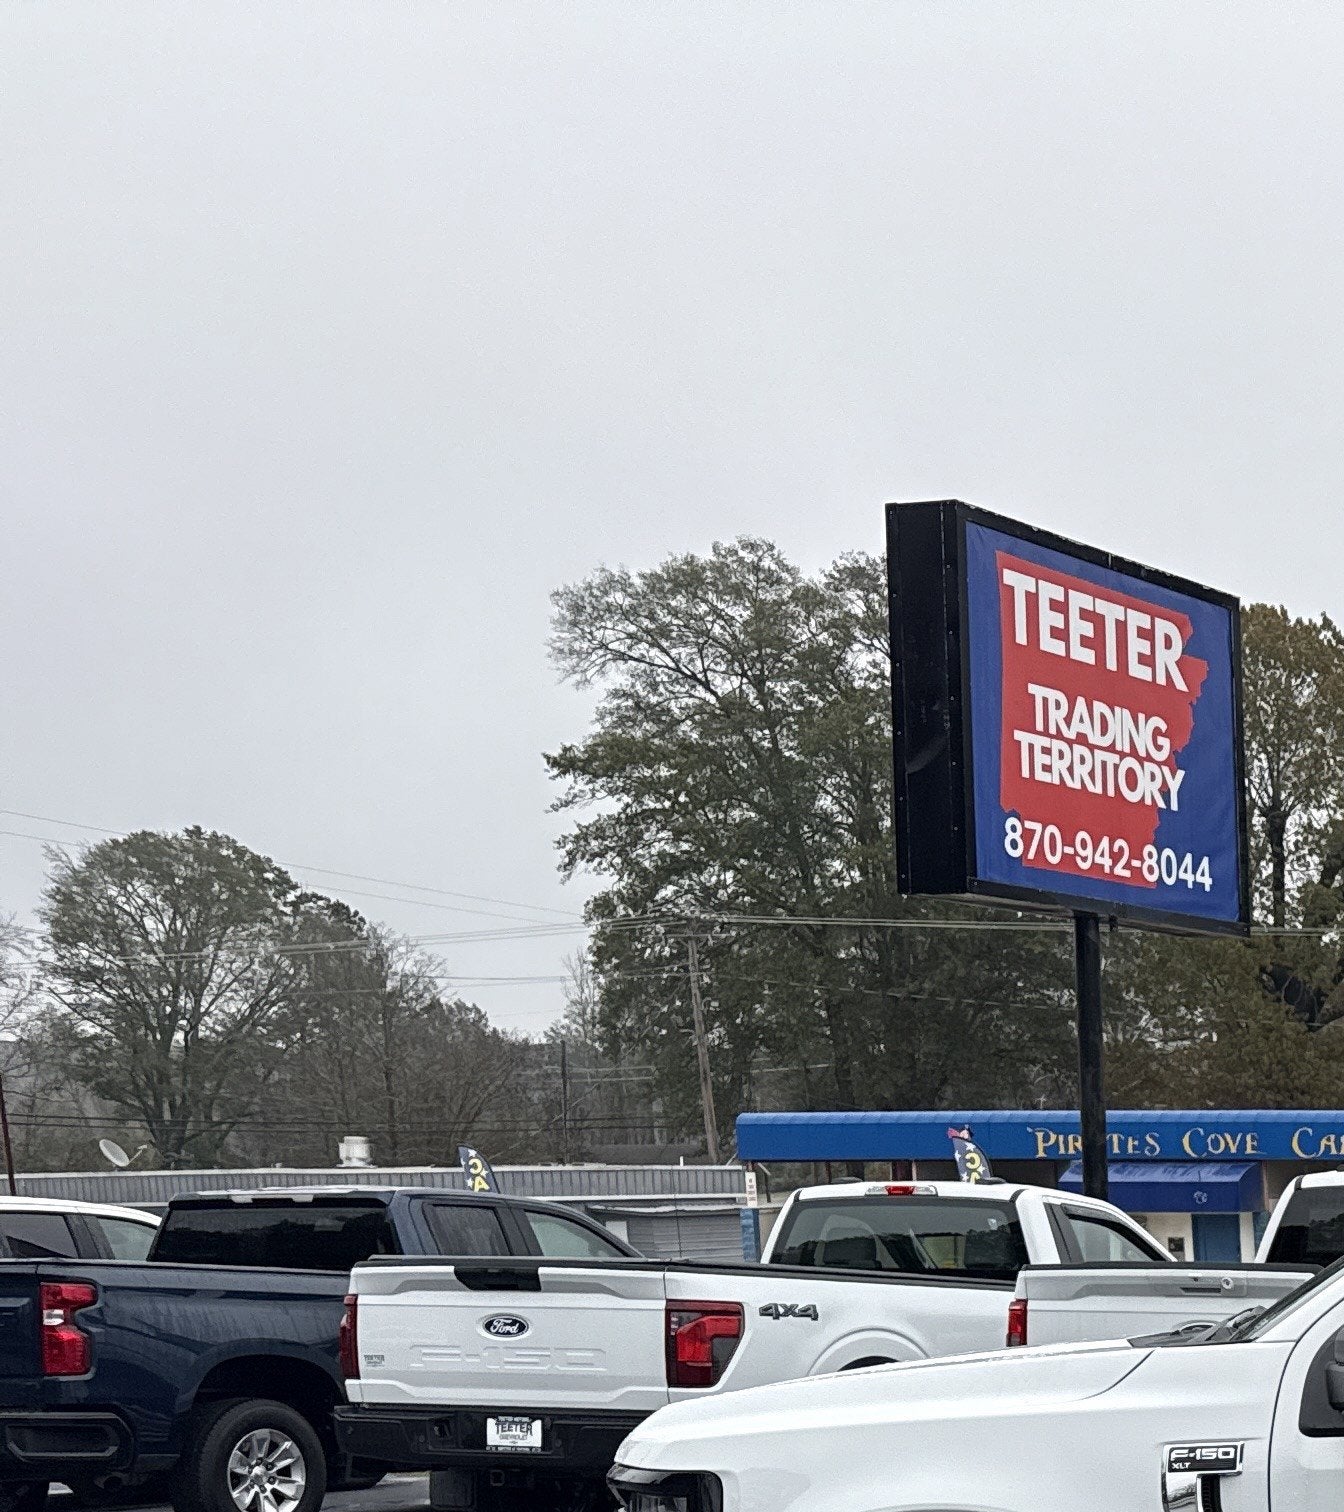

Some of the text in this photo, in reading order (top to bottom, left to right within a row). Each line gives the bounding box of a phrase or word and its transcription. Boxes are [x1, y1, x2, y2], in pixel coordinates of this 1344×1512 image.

[1002, 568, 1189, 692] TEETER
[1027, 684, 1171, 761] TRADING
[1013, 730, 1186, 812] TERRITORY
[1004, 817, 1213, 891] 870-942-8044
[1027, 1127, 1161, 1158] PIRTES
[489, 1317, 521, 1335] Ford
[409, 1344, 608, 1372] F-150
[495, 1420, 533, 1436] TEETER
[1170, 1447, 1236, 1462] F-150
[1171, 1462, 1191, 1470] XLT
